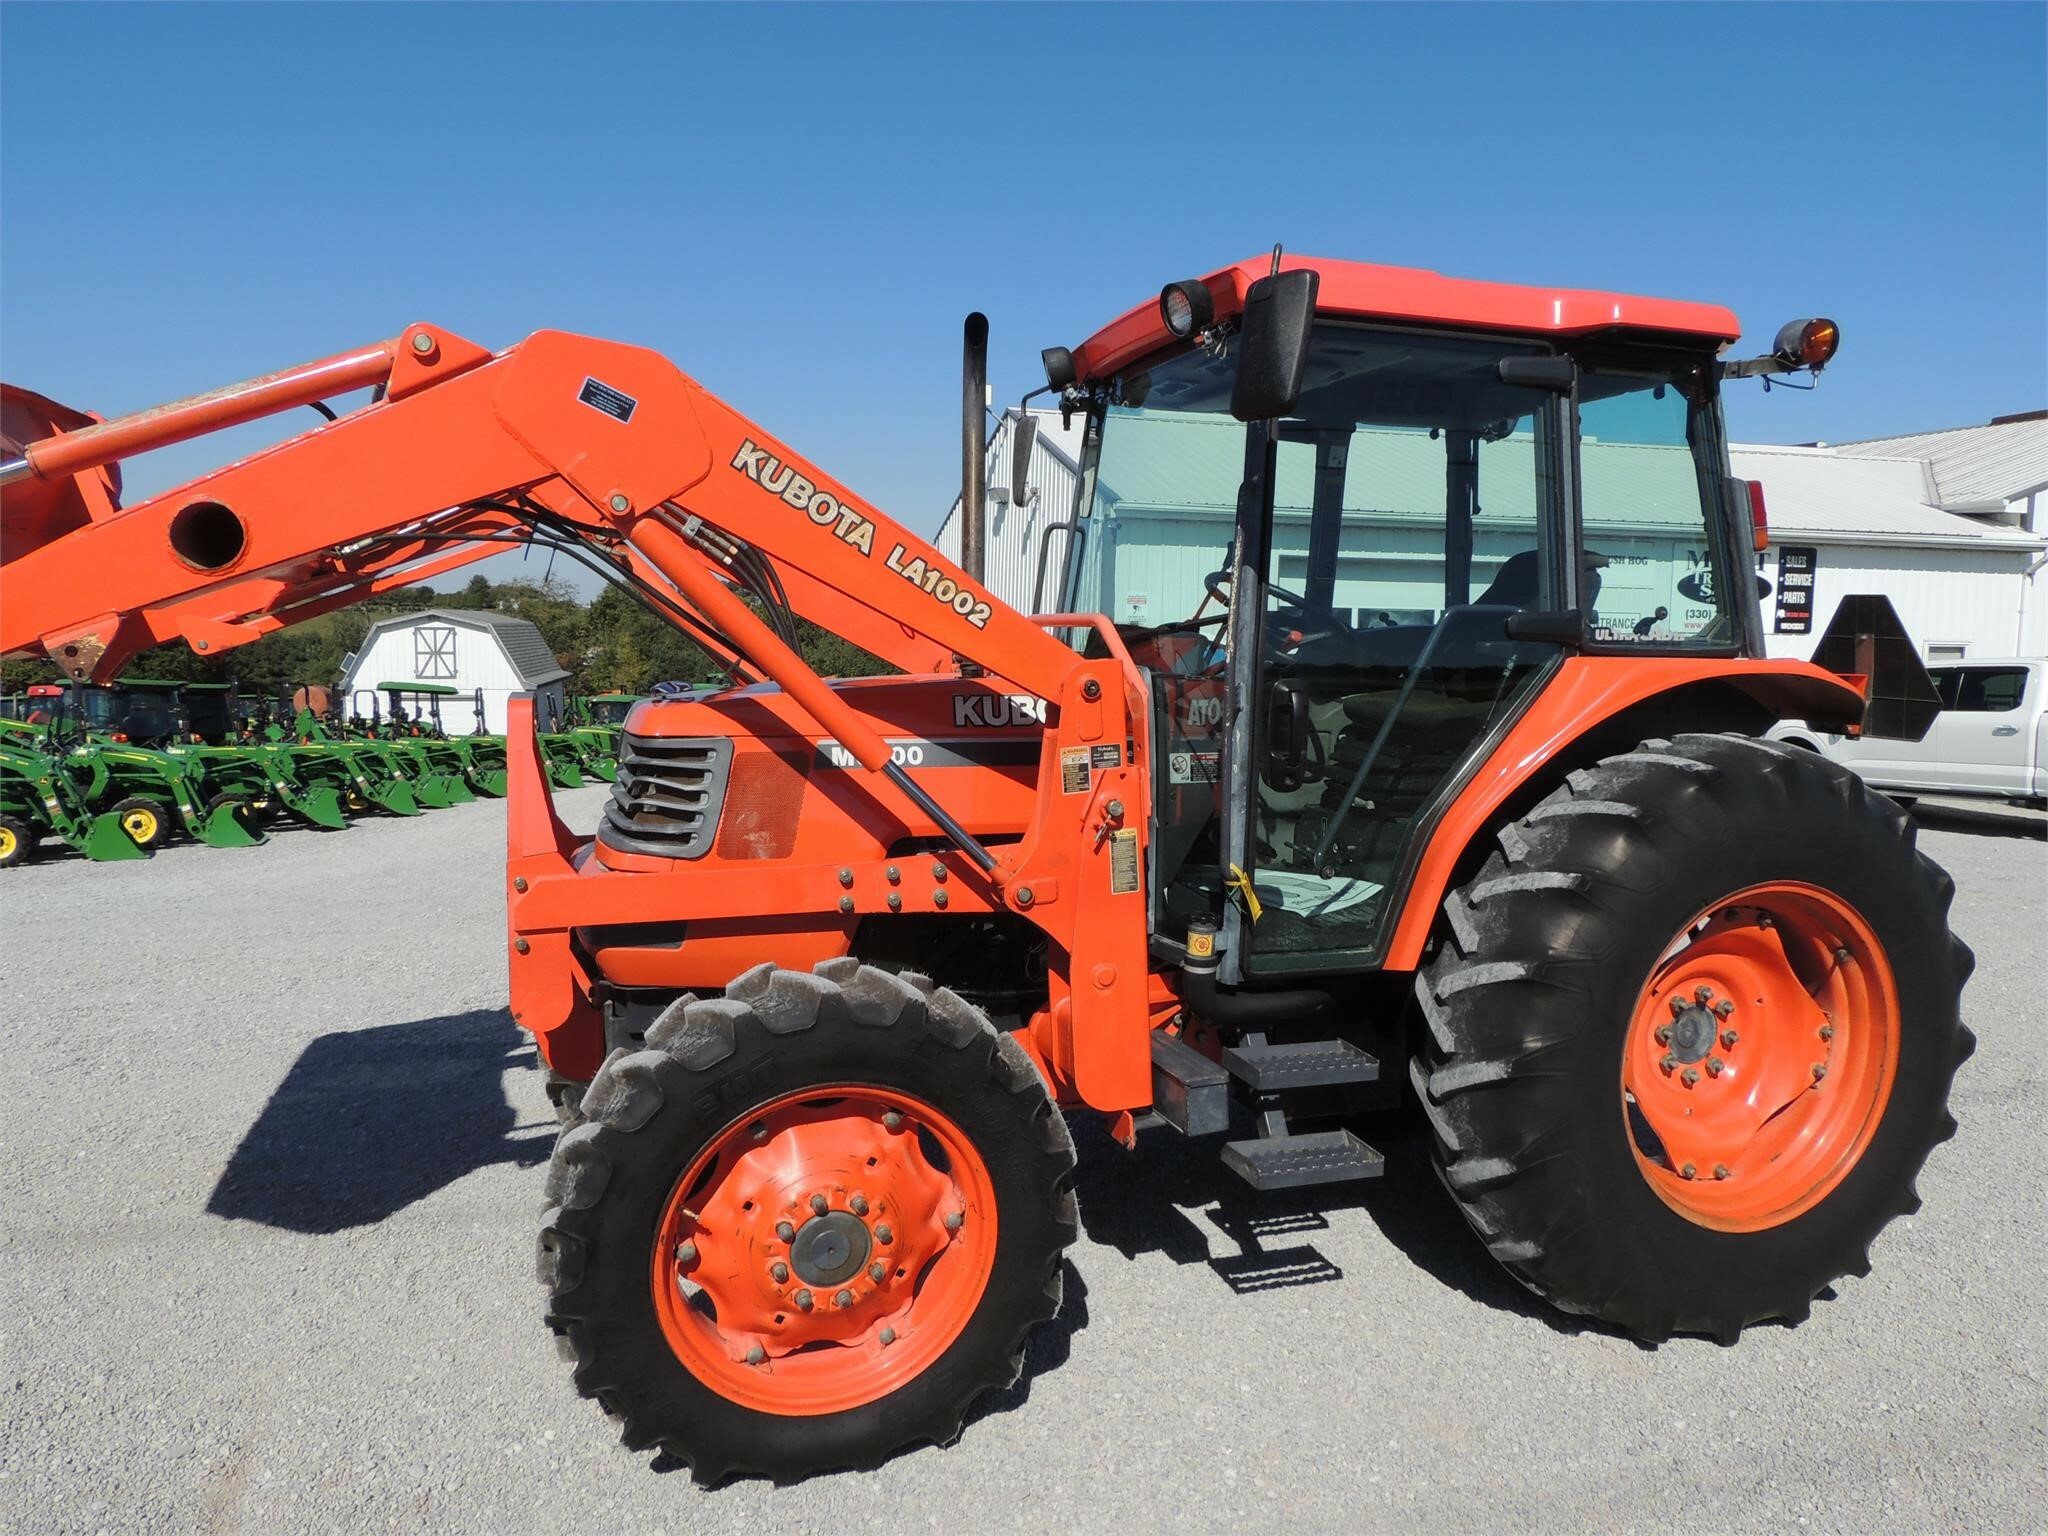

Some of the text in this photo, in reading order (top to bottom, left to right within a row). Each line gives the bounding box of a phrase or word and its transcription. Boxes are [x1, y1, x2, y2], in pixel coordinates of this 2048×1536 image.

[730, 438, 992, 630] KUBOTA LA1002
[1628, 556, 1648, 566] HOG
[1785, 555, 1807, 568] SALES
[1784, 573, 1813, 586] SERVICE
[1783, 591, 1806, 604] PARTS
[1685, 609, 1712, 620] (330)
[1599, 617, 1636, 629] TRANCE
[831, 746, 923, 766] M00
